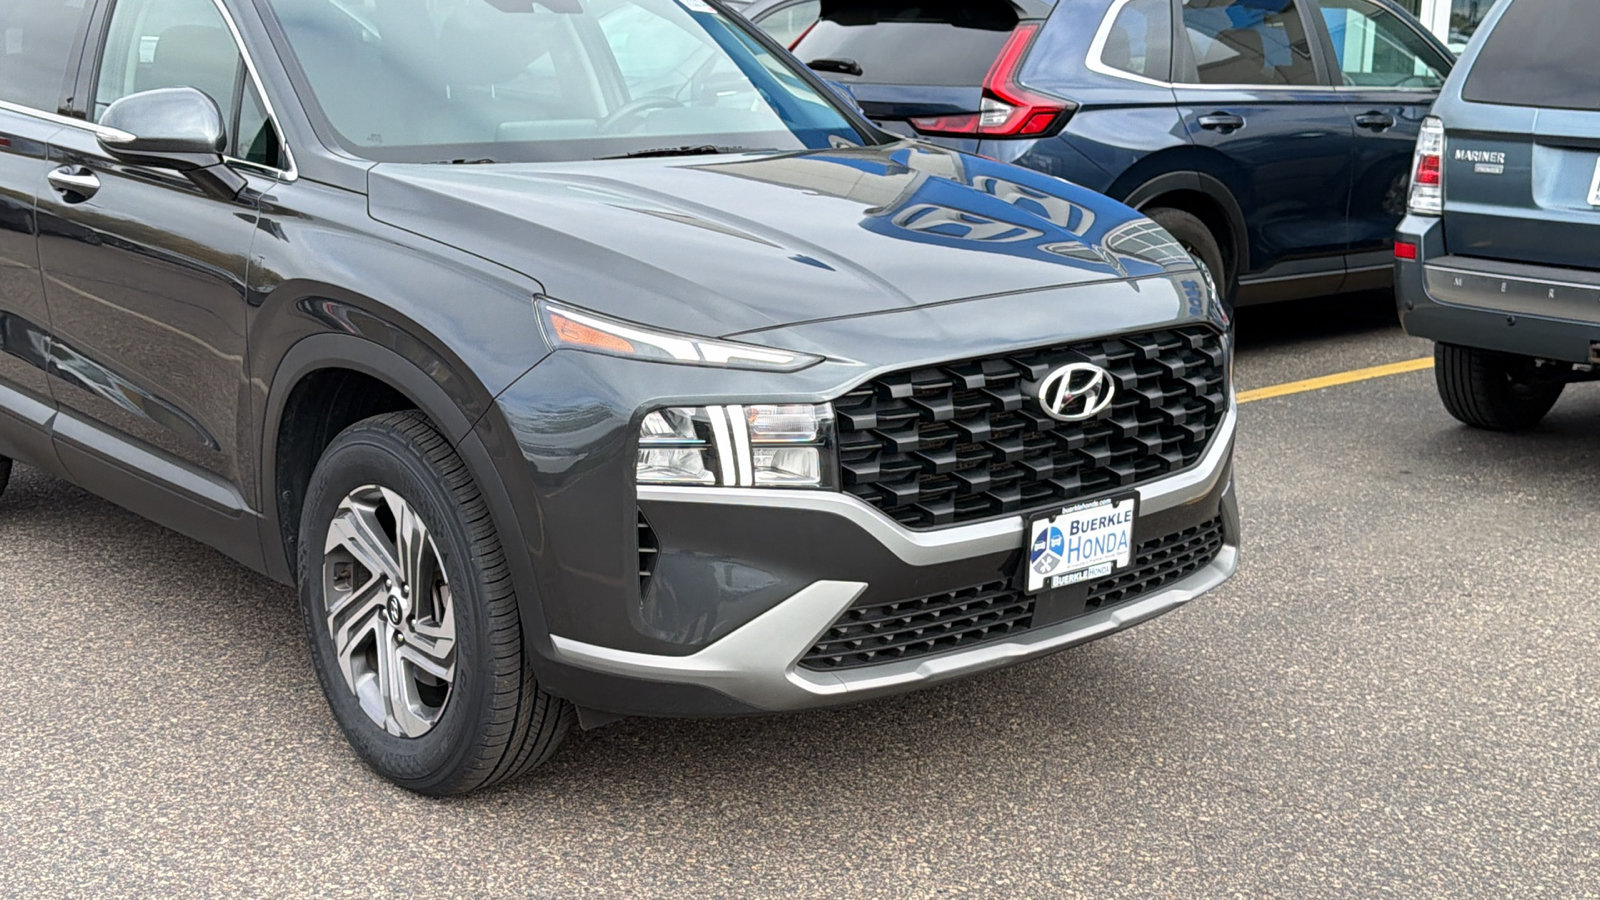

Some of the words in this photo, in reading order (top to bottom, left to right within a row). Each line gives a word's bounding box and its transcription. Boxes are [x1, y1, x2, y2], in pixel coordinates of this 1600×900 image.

[1455, 149, 1505, 164] MARINER
[1070, 510, 1131, 536] BUERKLE
[1067, 530, 1128, 564] HONDA
